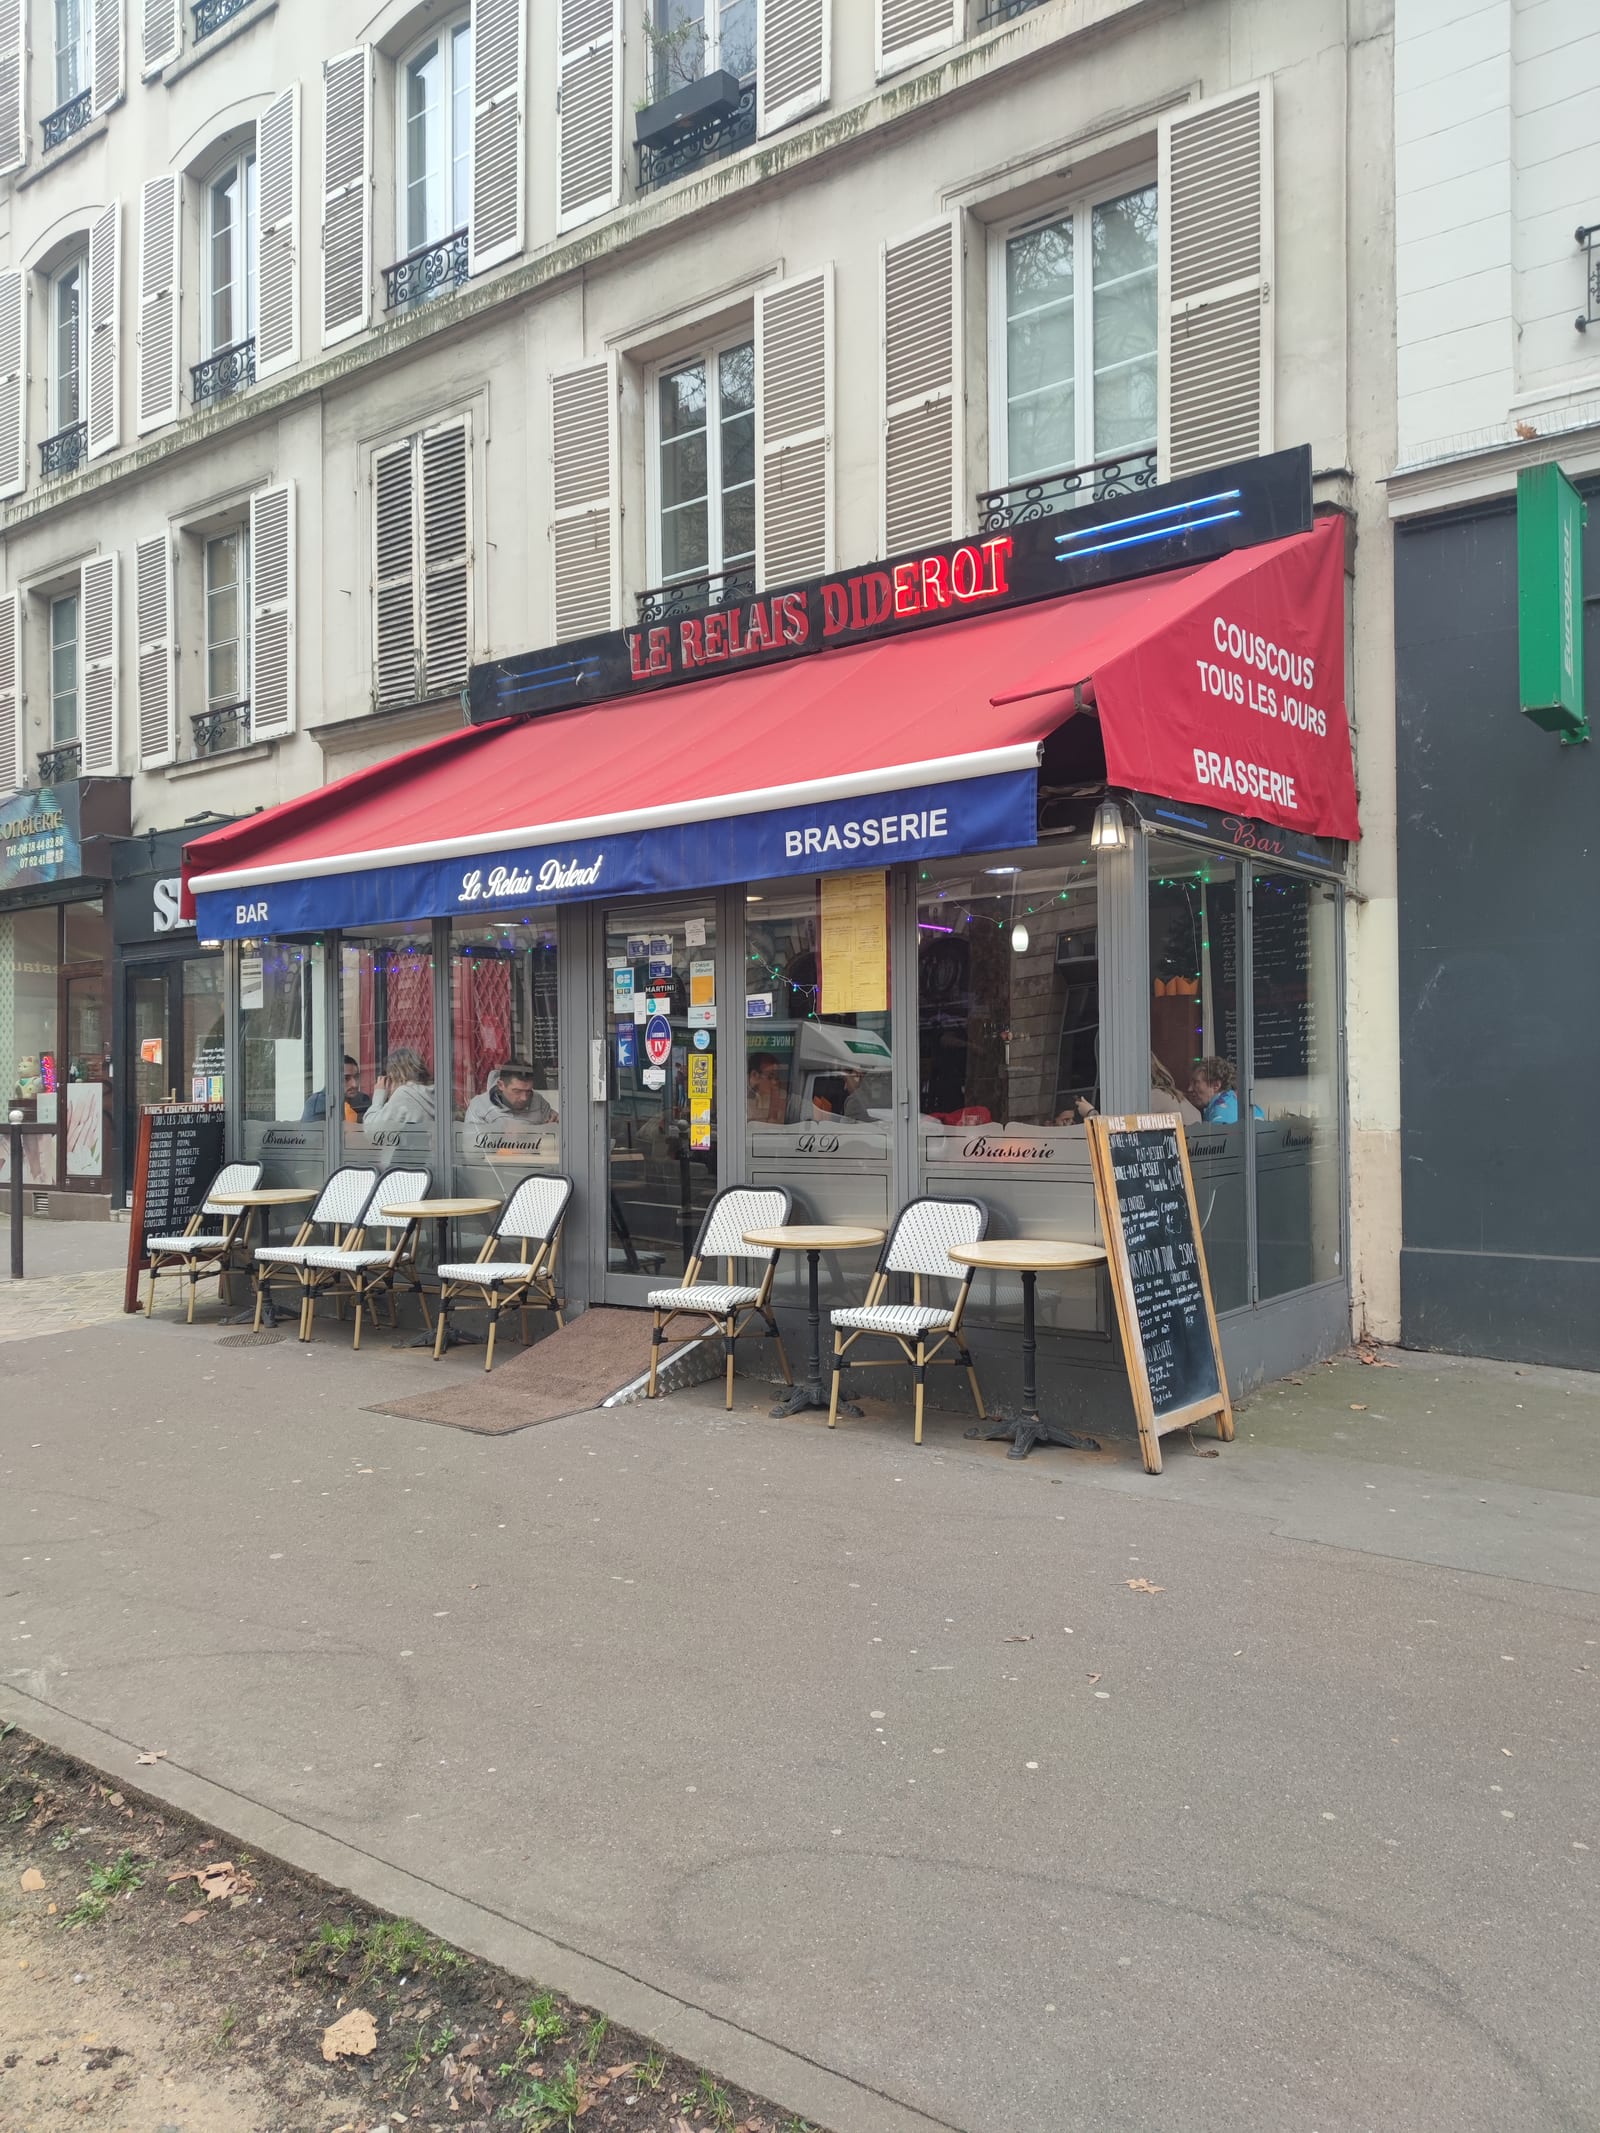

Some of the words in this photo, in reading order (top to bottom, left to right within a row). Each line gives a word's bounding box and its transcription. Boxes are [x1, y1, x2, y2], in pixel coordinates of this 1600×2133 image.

[629, 626, 672, 681] LE
[680, 591, 809, 669] RELAIS
[820, 535, 1014, 637] DIDEROT
[1563, 519, 1573, 677] Europcar
[1213, 617, 1315, 690] COUSCOUS
[1196, 660, 1244, 705] TOUS
[1248, 680, 1277, 718] LES
[1280, 695, 1327, 737] JOURS
[1193, 748, 1298, 809] BRASSERIE
[785, 808, 948, 857] BRASSERIE
[1221, 817, 1285, 854] Bar
[458, 869, 482, 901] Le
[482, 866, 533, 899] Relais
[536, 854, 603, 891] Diderot
[236, 902, 269, 924] BAR
[645, 984, 674, 993] MARTINI
[654, 1041, 663, 1052] IV
[153, 1115, 166, 1126] TOUS
[166, 1114, 176, 1125] LES
[177, 1113, 194, 1124] JOURS
[164, 1103, 205, 1114] COUSCOUS
[1108, 1116, 1126, 1130] NOS
[1136, 1114, 1176, 1129] FORMULES
[262, 1129, 306, 1145] Brasserie
[473, 1131, 543, 1150] Restaurant
[962, 1135, 1055, 1159] Brasserie
